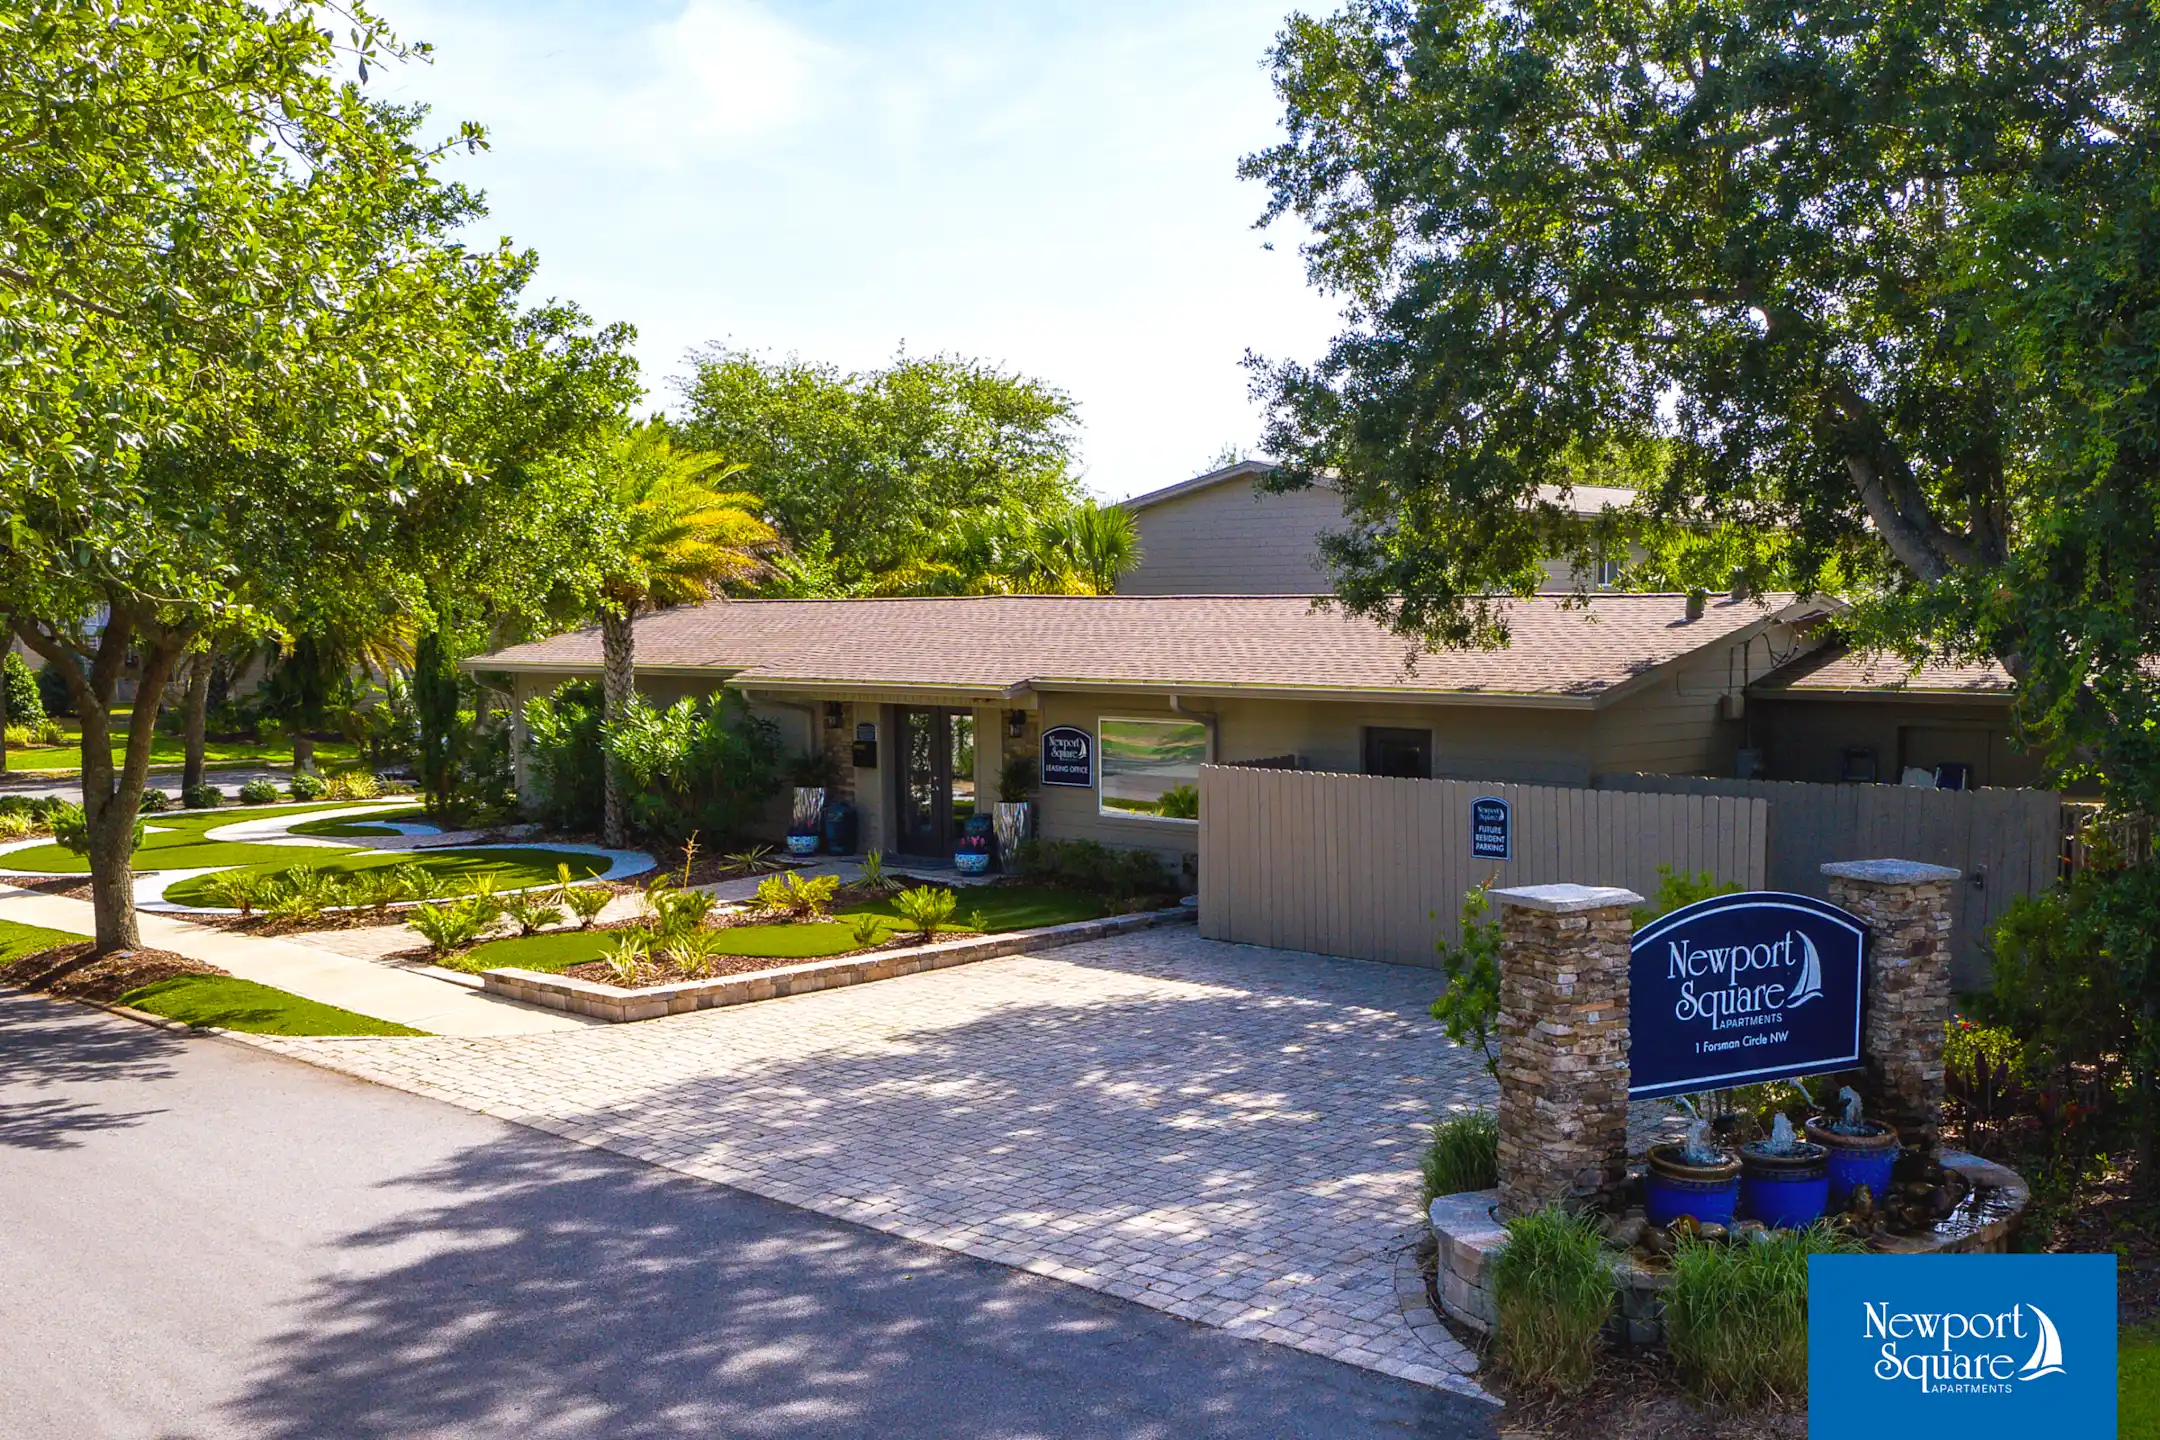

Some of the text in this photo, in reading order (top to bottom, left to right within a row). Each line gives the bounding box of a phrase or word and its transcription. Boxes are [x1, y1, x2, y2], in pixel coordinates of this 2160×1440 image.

[1046, 764, 1088, 774] LEASING OFFICE
[1479, 825, 1502, 834] FUTURE
[1476, 834, 1505, 843] RESIDENT
[1476, 842, 1504, 852] PARKING
[1667, 930, 1796, 986] Newport
[1675, 980, 1786, 1031] Square
[1720, 1013, 1783, 1029] APARTMENTS
[1695, 1030, 1789, 1054] 1 Forsman Circle NW
